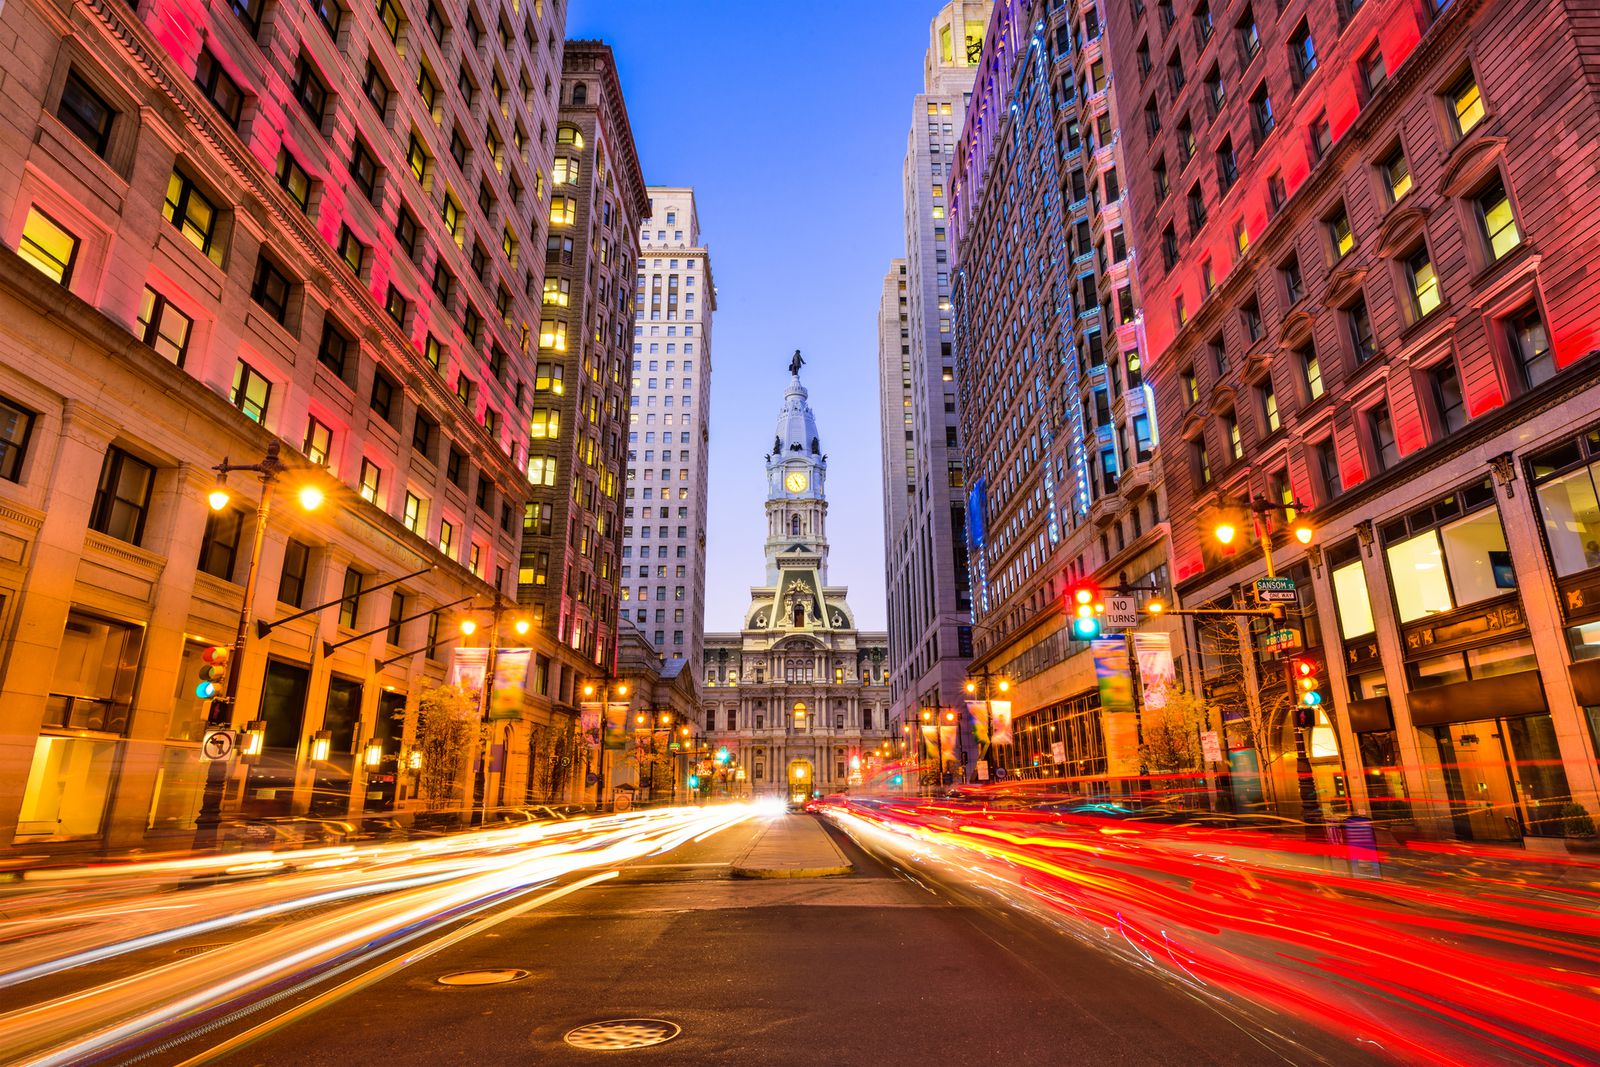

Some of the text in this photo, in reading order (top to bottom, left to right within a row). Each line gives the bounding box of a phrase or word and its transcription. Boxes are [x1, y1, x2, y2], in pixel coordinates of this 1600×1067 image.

[1257, 581, 1286, 590] SANSOM
[1112, 600, 1127, 611] NO
[1107, 614, 1136, 623] TURNS
